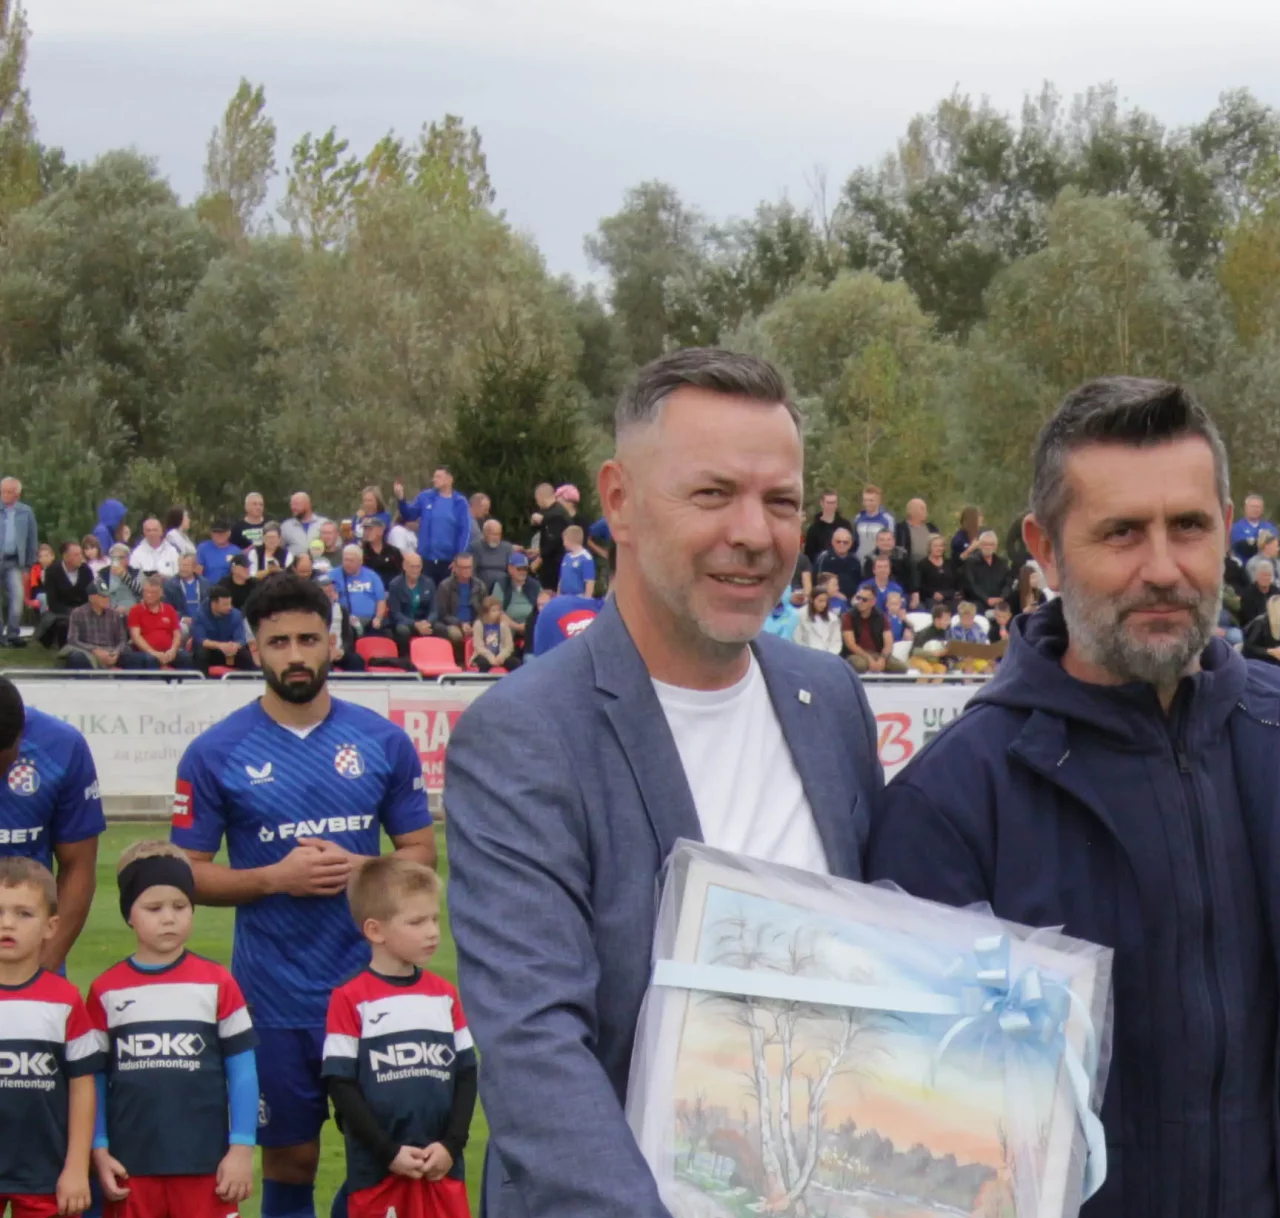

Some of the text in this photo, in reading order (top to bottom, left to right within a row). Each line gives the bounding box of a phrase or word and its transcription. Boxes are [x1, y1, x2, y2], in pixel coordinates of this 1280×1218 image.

[278, 814, 375, 840] FAVBET
[116, 1033, 200, 1059] NDK
[118, 1058, 200, 1072] Industriemontage
